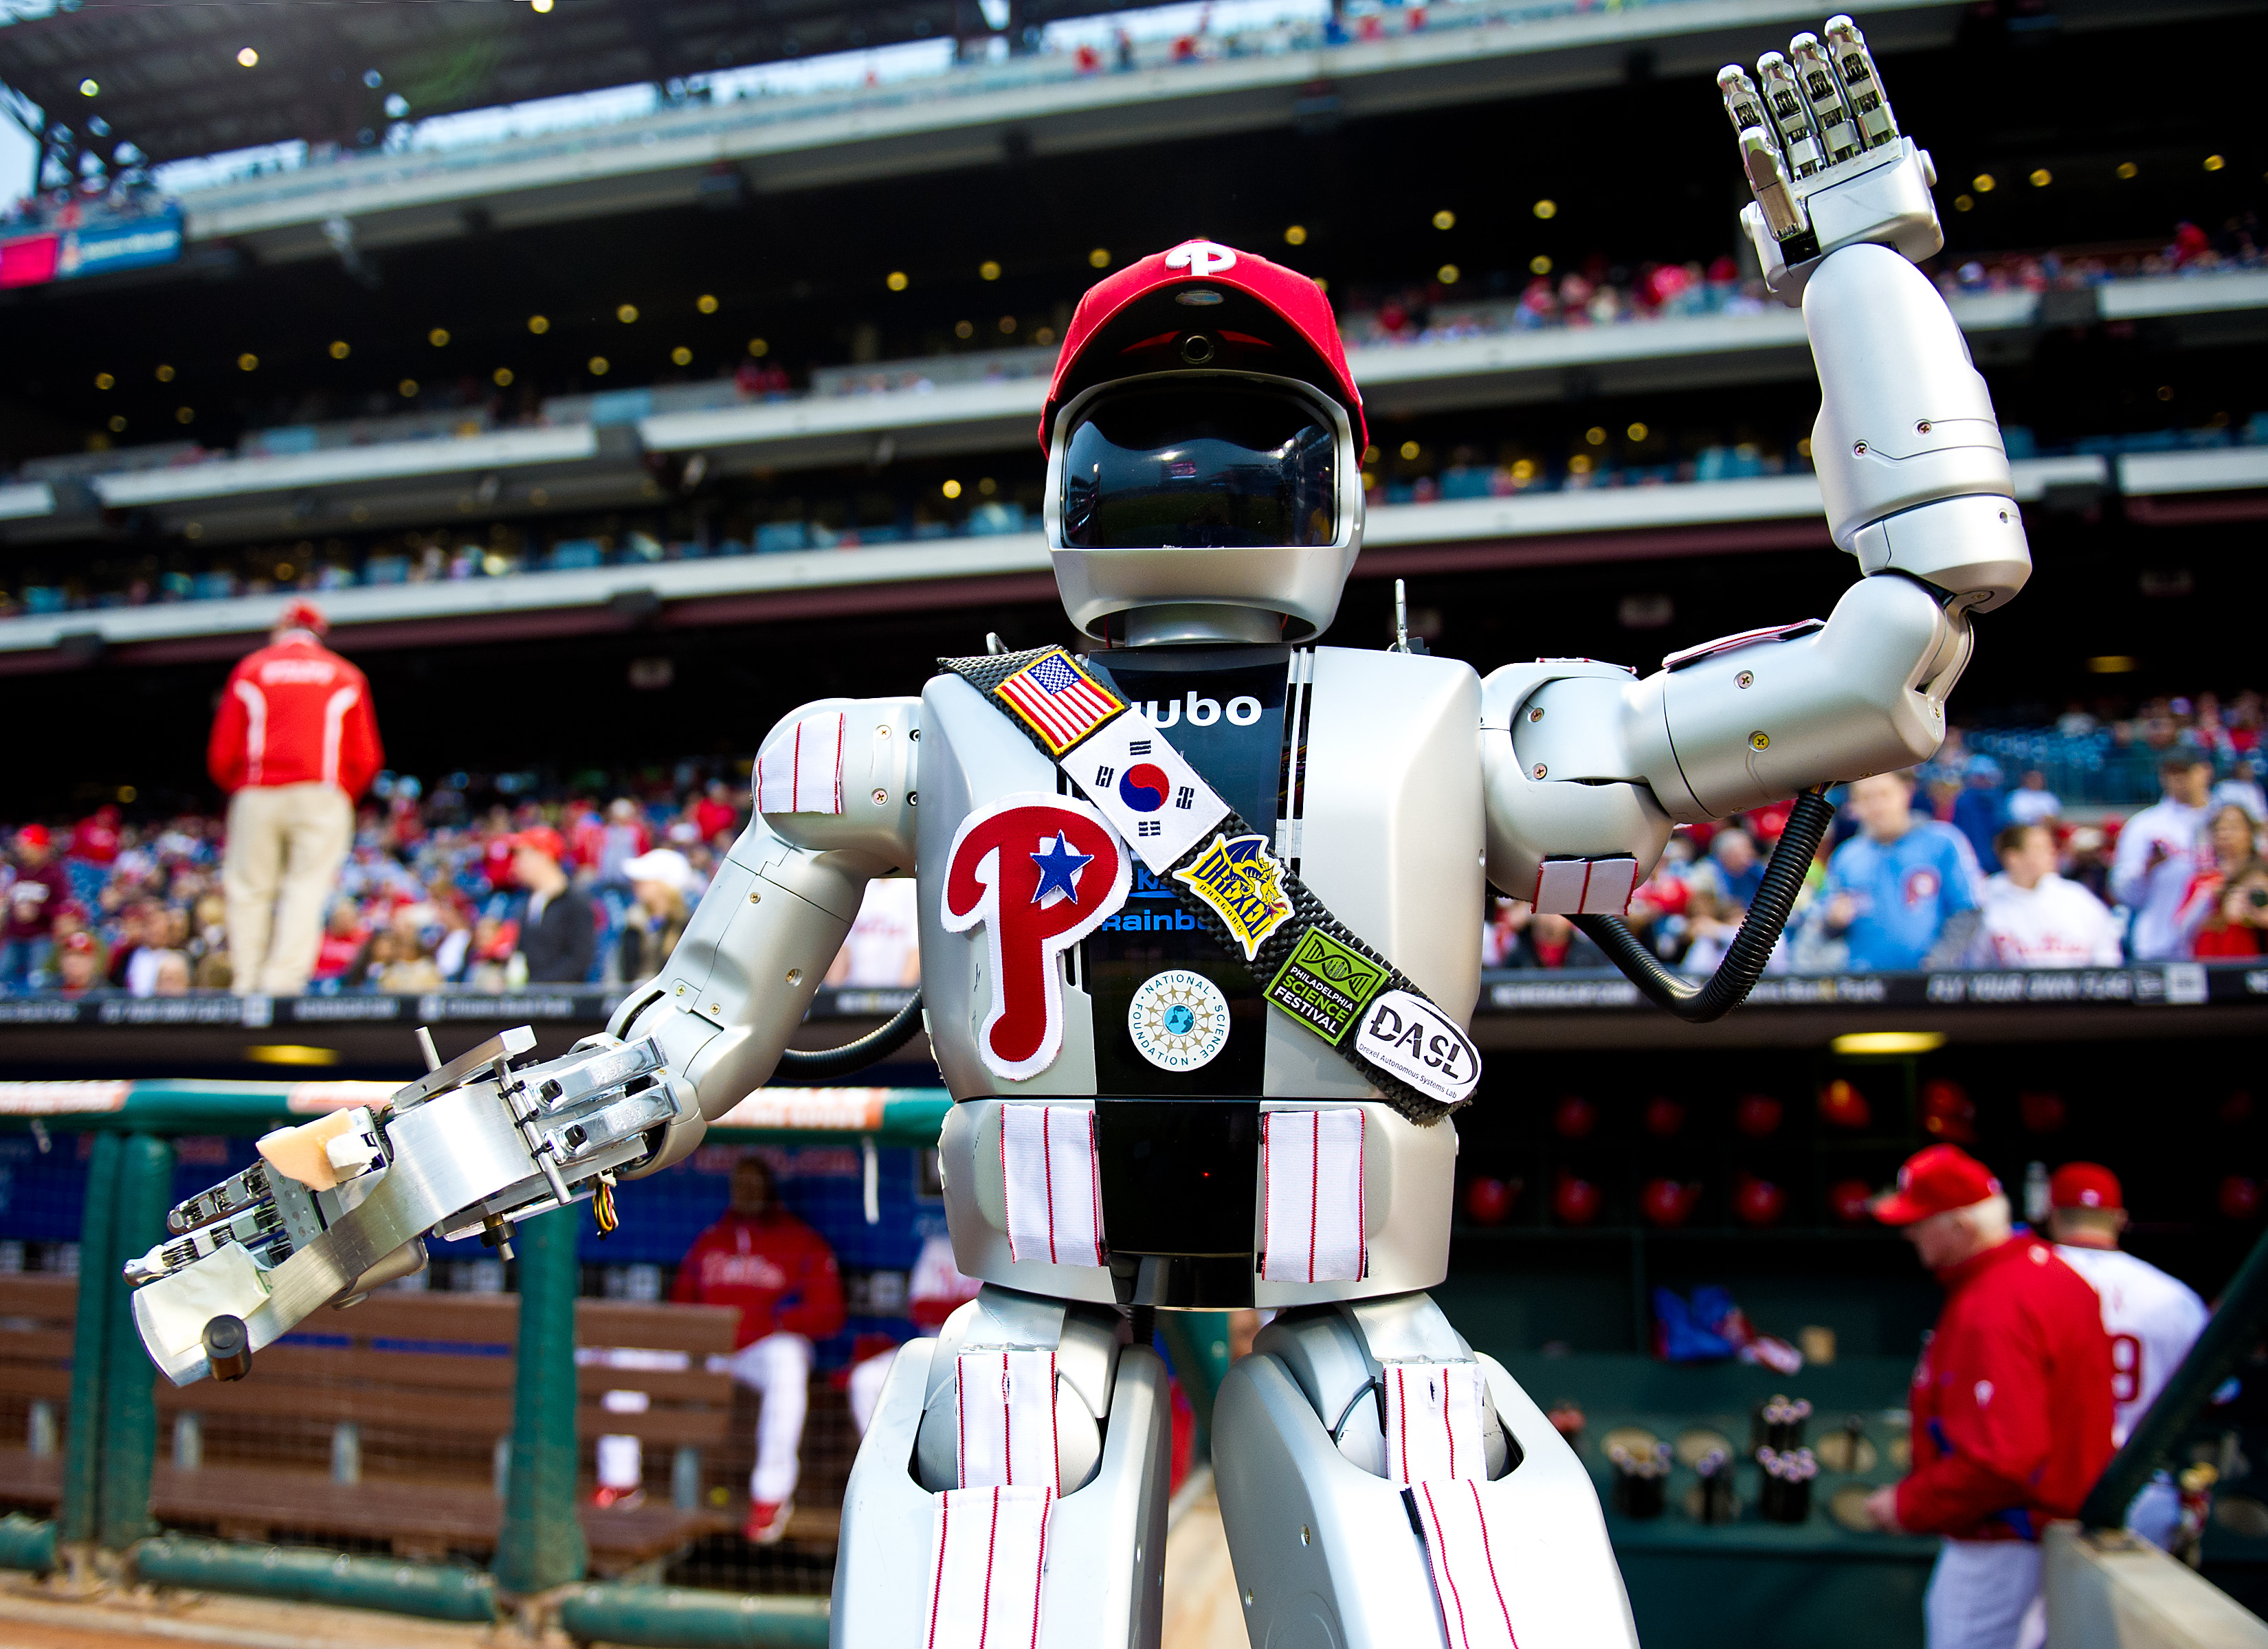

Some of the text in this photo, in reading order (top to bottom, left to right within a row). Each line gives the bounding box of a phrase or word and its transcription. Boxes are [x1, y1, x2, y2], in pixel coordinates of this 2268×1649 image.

[1166, 242, 1236, 276] P
[1131, 691, 1263, 728] ubo
[1192, 847, 1271, 941] DREXEL
[948, 805, 1119, 1063] P
[1145, 974, 1209, 995] NATIONAL
[1274, 985, 1337, 1034] FESTIVAL
[1282, 974, 1349, 1023] SCIENCE
[1290, 966, 1354, 1011] PHILADELPHIA
[1133, 1003, 1189, 1066] FOUNDATION
[1199, 1005, 1225, 1059] SCIENCE
[1369, 1005, 1460, 1079] DASL
[1359, 1043, 1457, 1099] Drexel Autonomous Systems Lab
